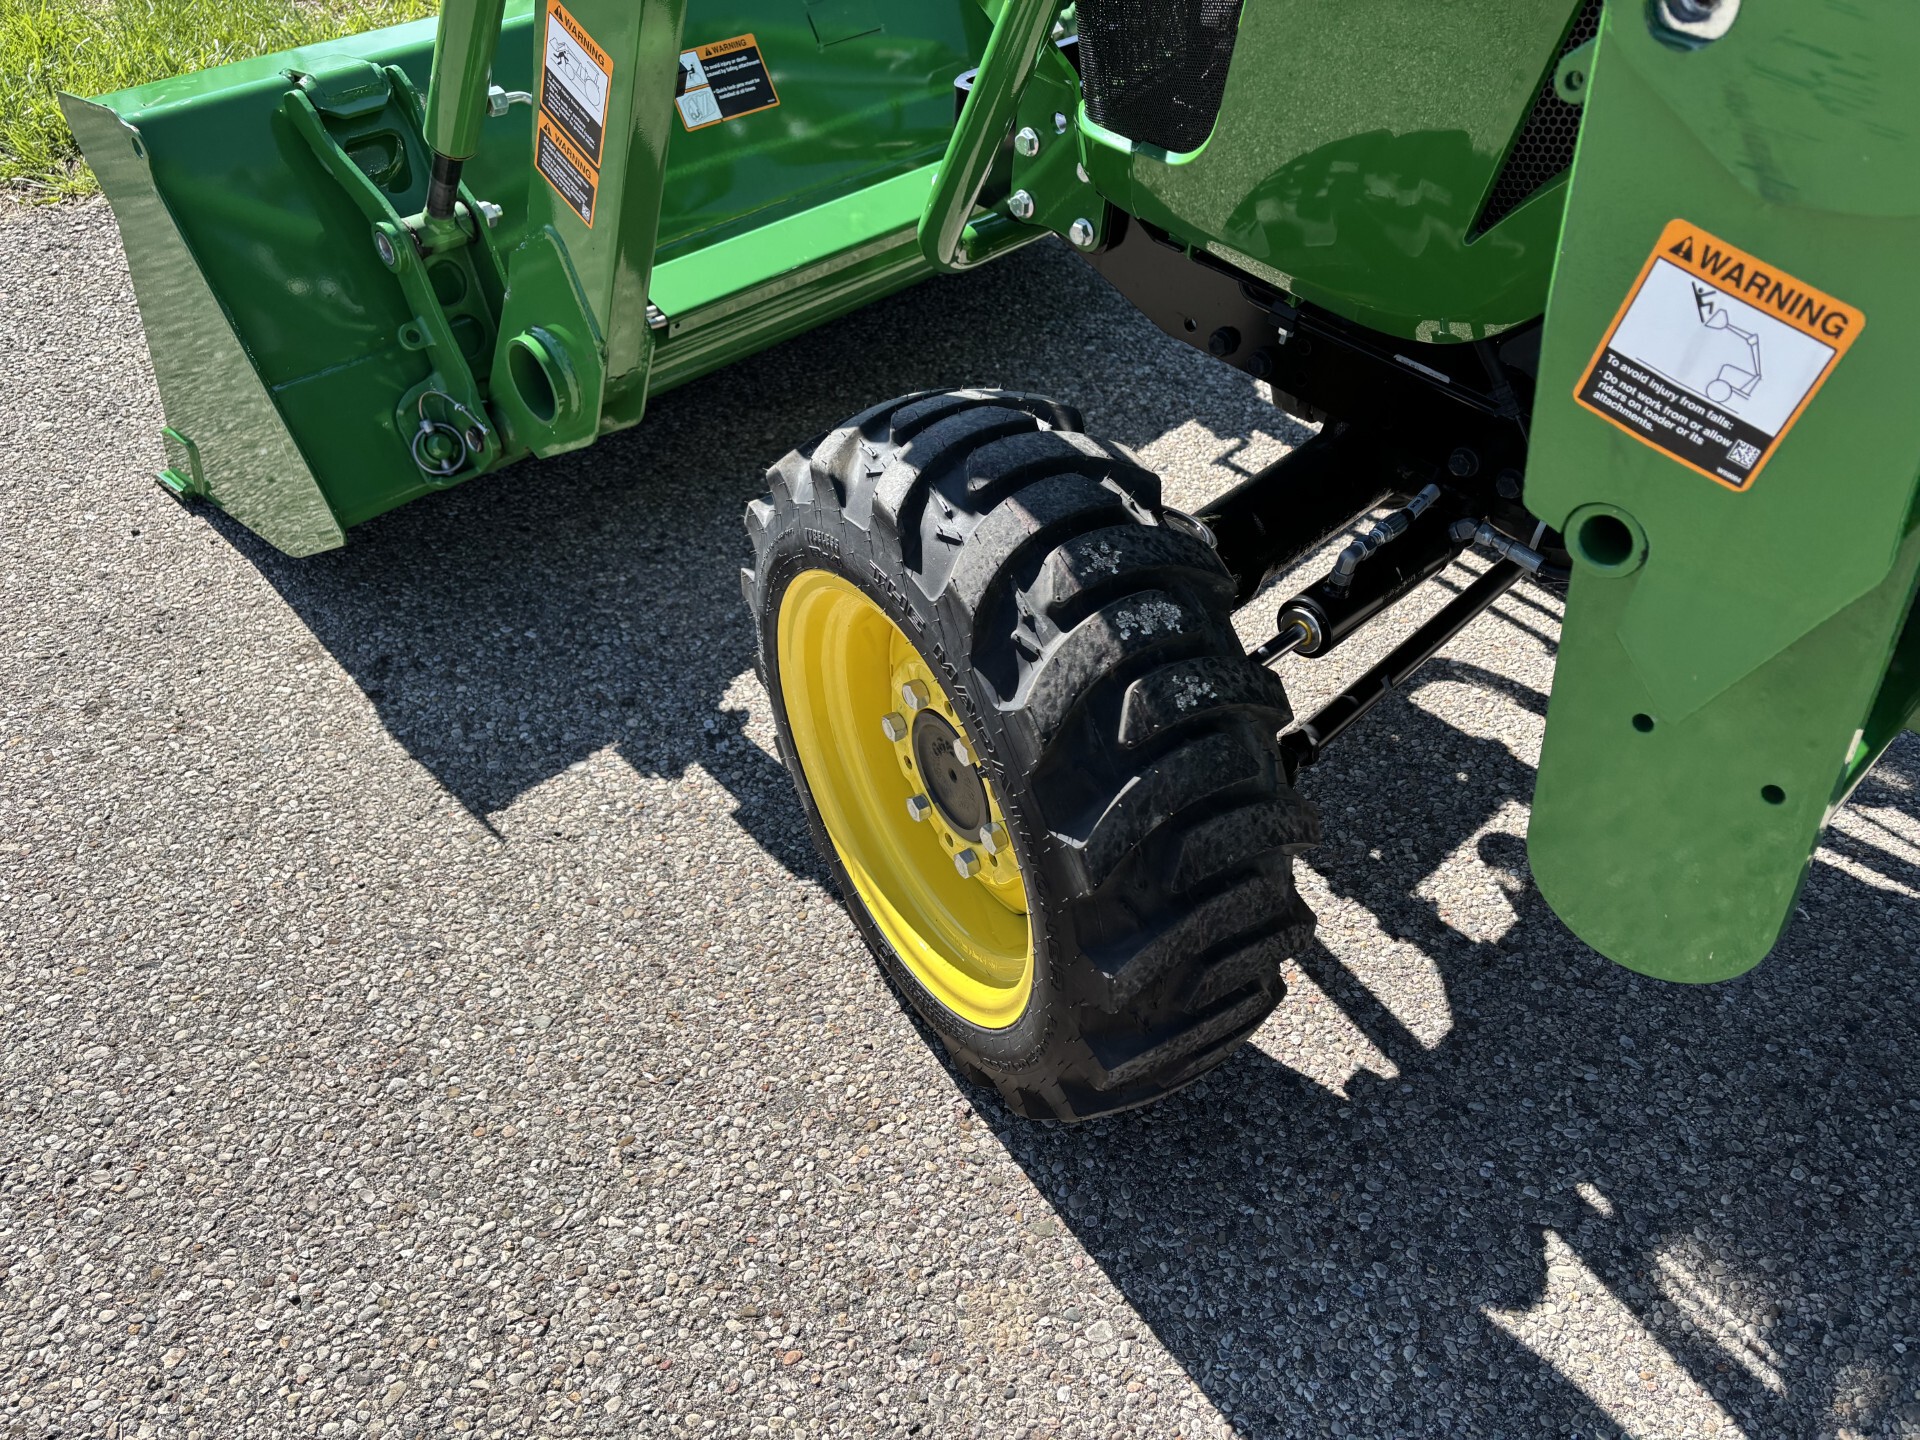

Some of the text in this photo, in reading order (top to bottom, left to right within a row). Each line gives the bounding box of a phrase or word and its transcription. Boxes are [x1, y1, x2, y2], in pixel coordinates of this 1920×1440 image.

[565, 16, 605, 67] WARNING
[712, 39, 747, 54] WARNING
[554, 133, 592, 180] WARNING
[1701, 244, 1849, 339] WARNING
[1594, 392, 1652, 430] attachments.
[1598, 382, 1703, 444] riders on loader or its
[1603, 371, 1731, 446] Do not work from or allow
[1608, 354, 1733, 429] To avoid injury from falls:
[869, 560, 926, 633] THE
